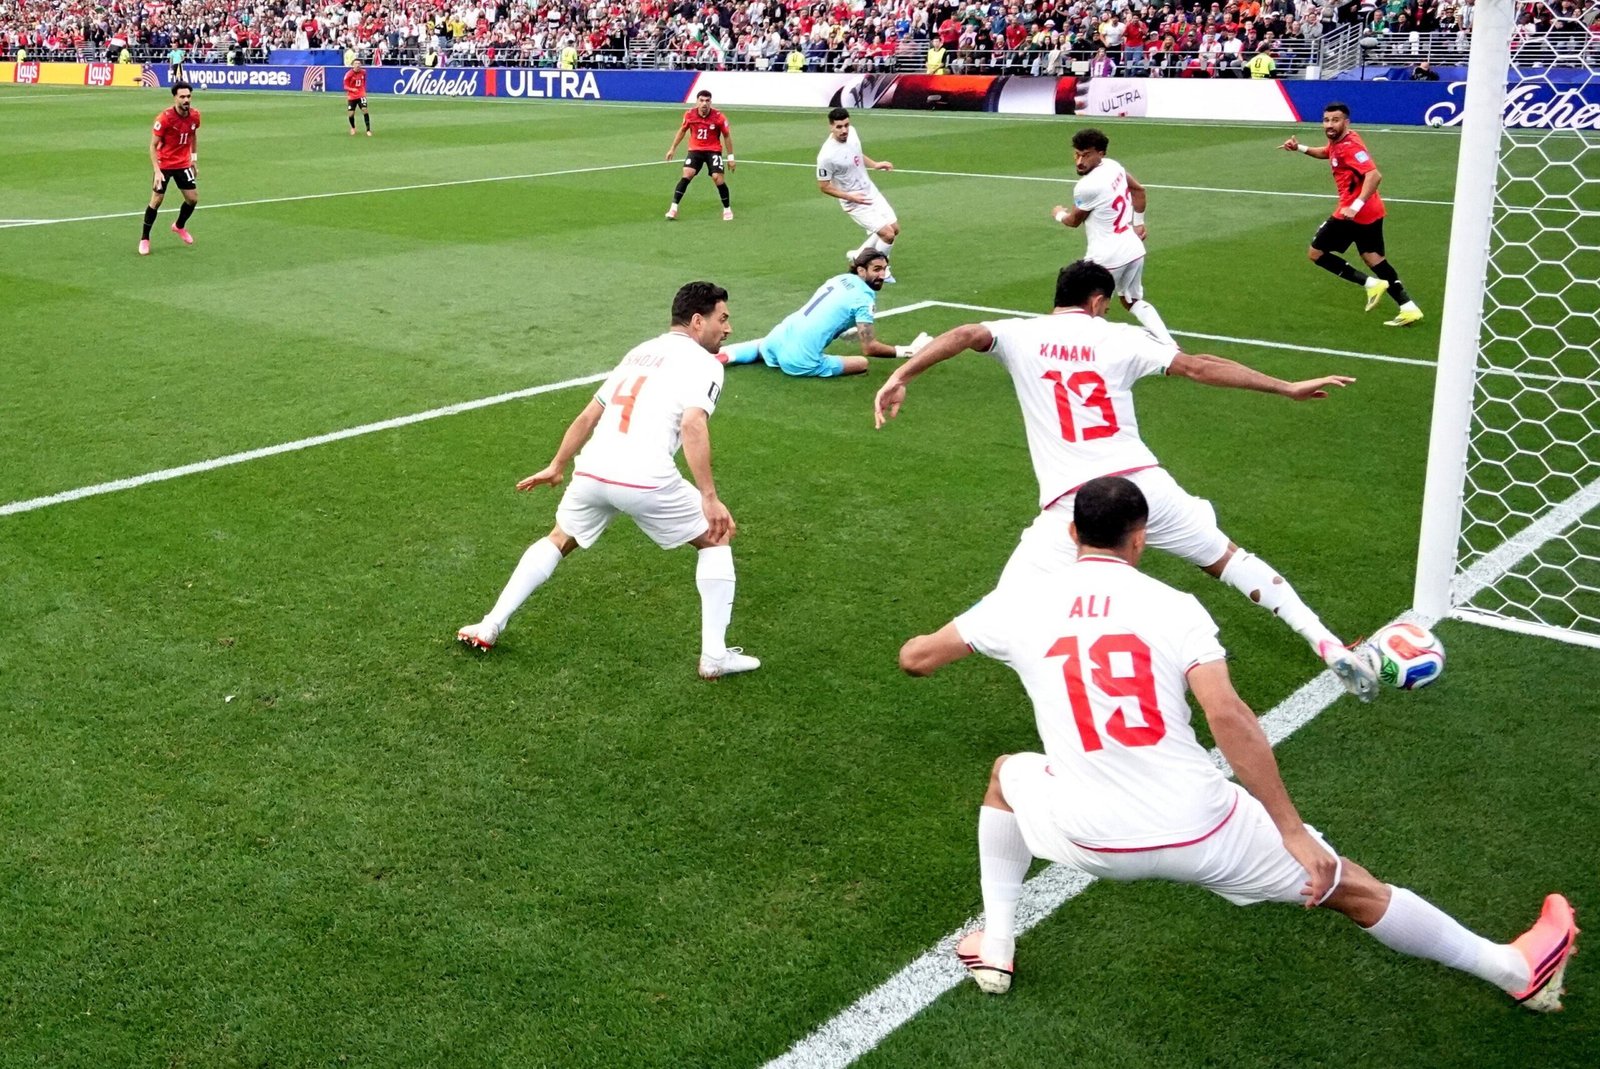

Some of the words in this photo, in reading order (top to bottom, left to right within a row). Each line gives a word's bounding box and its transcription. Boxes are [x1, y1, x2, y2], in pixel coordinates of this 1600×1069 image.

[17, 62, 38, 84] Lay's
[88, 63, 112, 86] Lay's
[189, 70, 226, 84] WORLD
[227, 71, 248, 85] CUP
[249, 71, 287, 85] 2026
[393, 67, 478, 96] Michelob
[505, 70, 600, 98] ULTRA
[1101, 89, 1141, 112] ULTRA
[179, 132, 188, 145] 11
[697, 128, 708, 140] 21
[712, 154, 724, 166] 21
[184, 167, 195, 182] 11
[803, 286, 835, 317] 1
[1039, 343, 1096, 362] KANANI
[611, 376, 648, 434] 4
[1040, 370, 1120, 443] 13
[1069, 595, 1111, 618] ALI
[1043, 634, 1167, 752] 19
